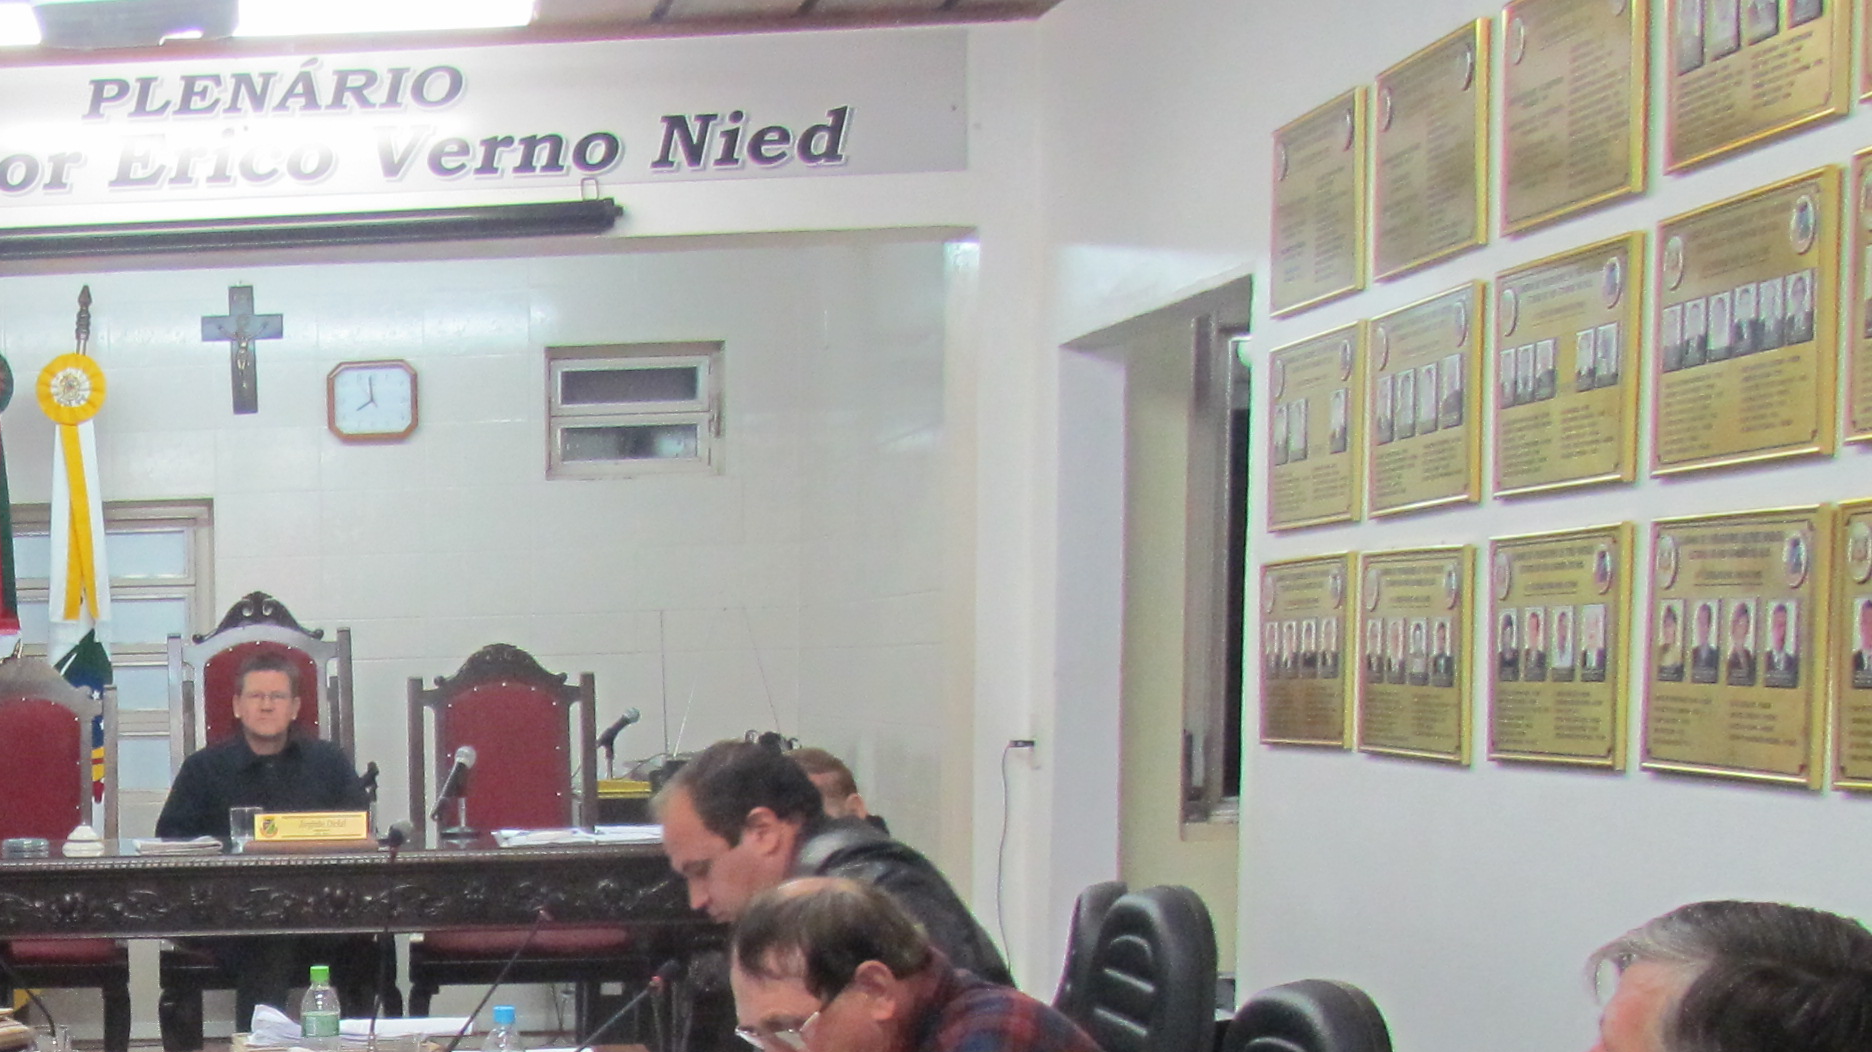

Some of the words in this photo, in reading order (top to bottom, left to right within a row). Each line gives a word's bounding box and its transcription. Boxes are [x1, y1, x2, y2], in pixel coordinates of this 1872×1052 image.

[81, 56, 466, 121] PLENÁRIO
[375, 125, 624, 180] Verno
[650, 105, 852, 171] Nied
